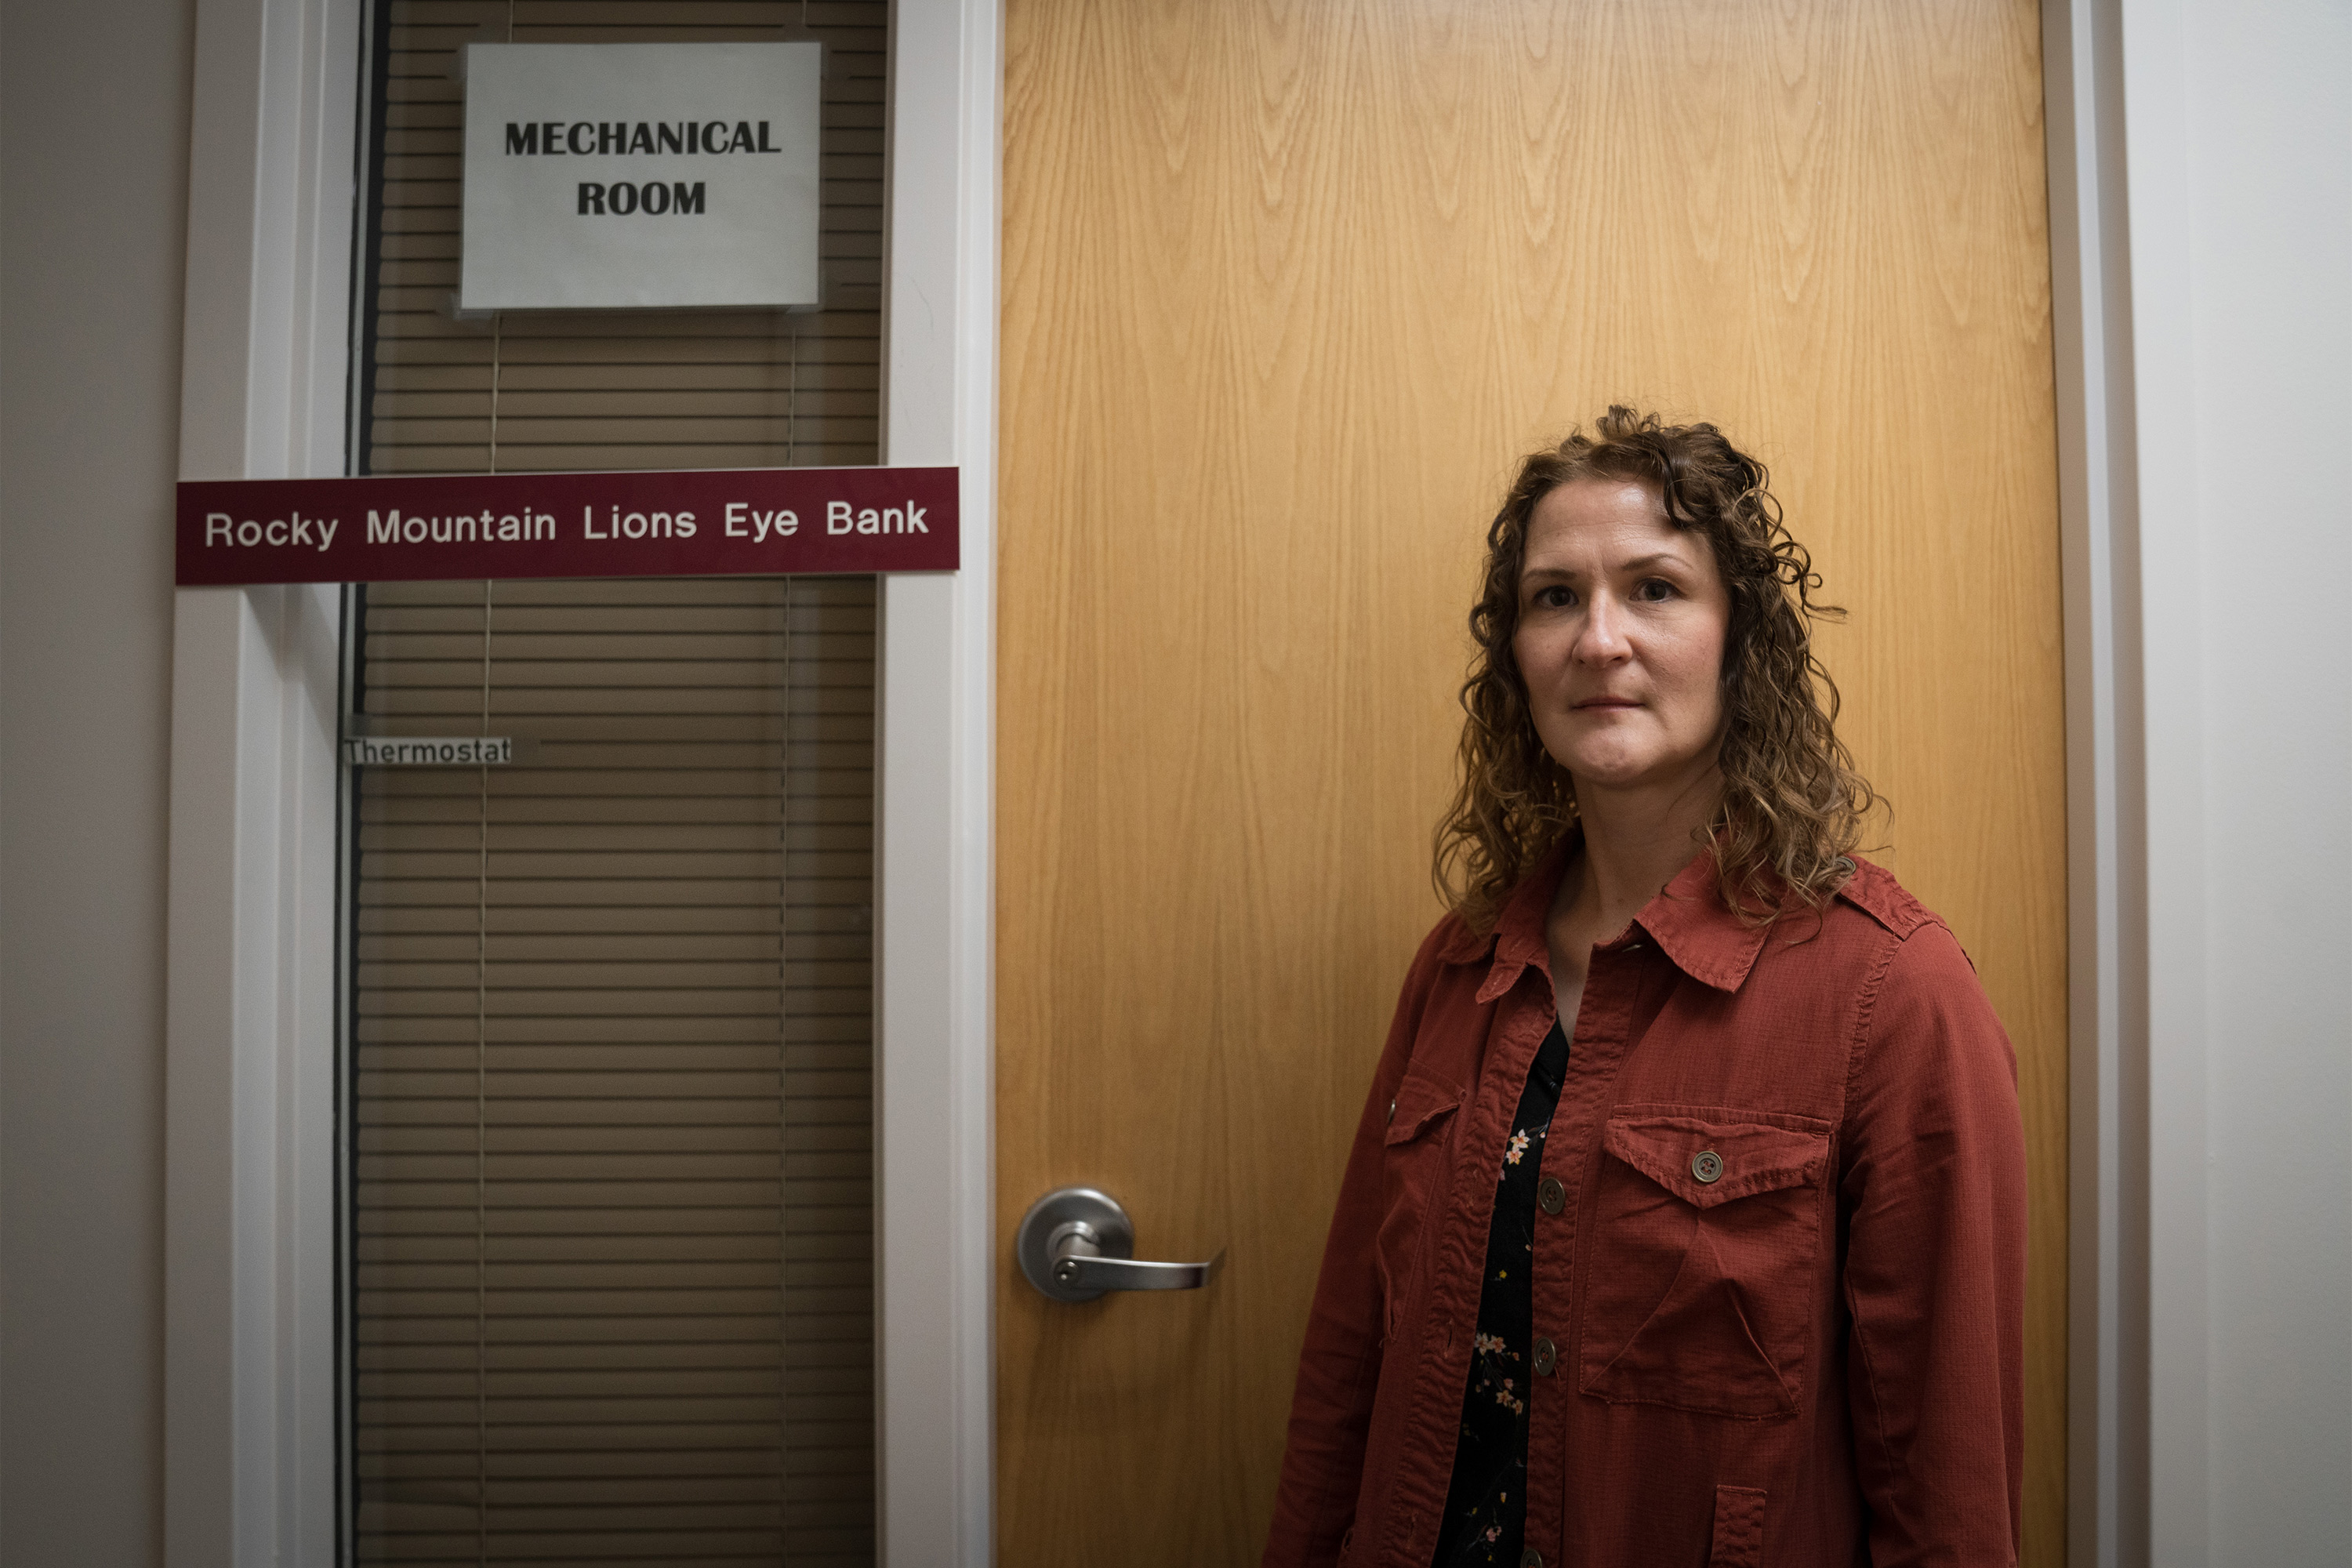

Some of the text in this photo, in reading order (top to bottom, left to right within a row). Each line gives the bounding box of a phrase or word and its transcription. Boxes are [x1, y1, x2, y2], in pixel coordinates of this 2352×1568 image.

[506, 121, 782, 155] MECHANICAL
[578, 182, 706, 216] ROOM
[205, 500, 929, 552] Rocky Mountain Lions Eye Bank
[343, 739, 510, 763] Thermostat
